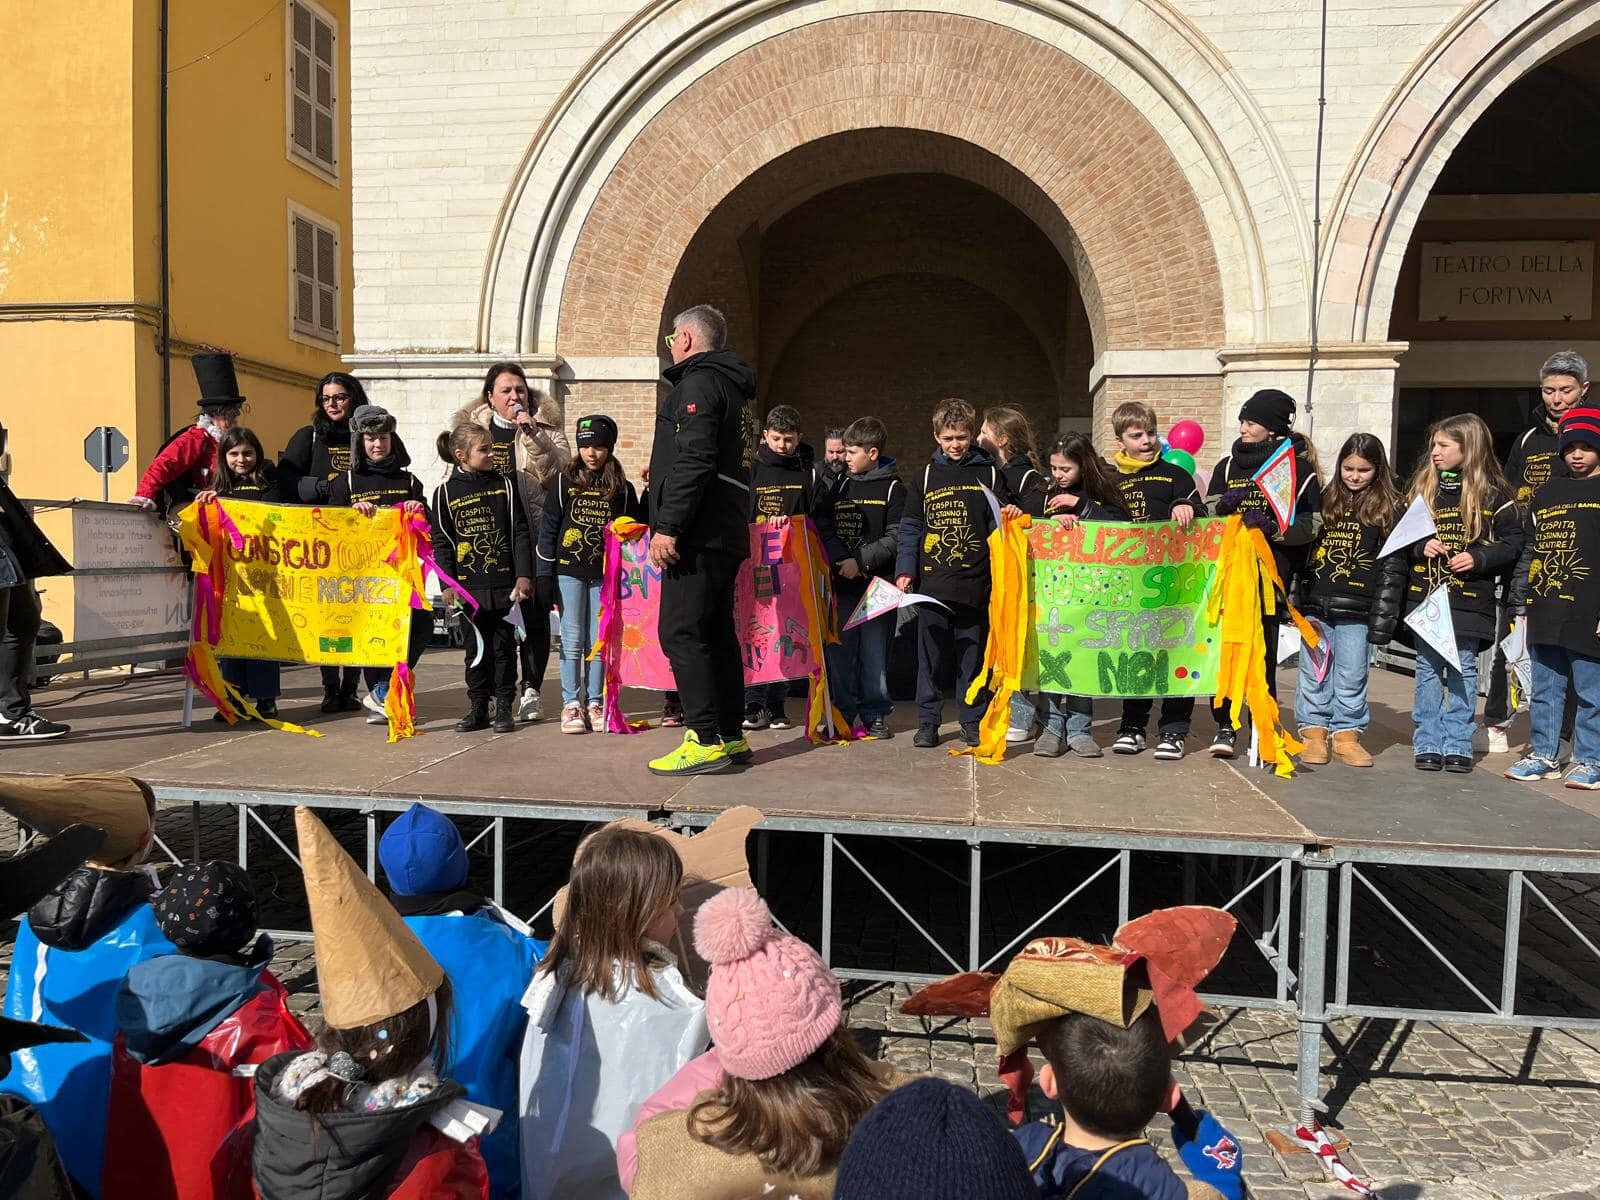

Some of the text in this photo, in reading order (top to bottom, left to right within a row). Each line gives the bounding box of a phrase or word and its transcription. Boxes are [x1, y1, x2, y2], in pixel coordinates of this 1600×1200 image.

[1433, 255, 1584, 273] TEATRO DELLA
[1459, 286, 1553, 305] FORTVNA
[935, 510, 961, 519] STANNO
[1540, 520, 1577, 532] CASPITA,
[1326, 531, 1354, 540] STANNO
[1321, 539, 1353, 548] SENTIRE
[1537, 540, 1568, 550] SENTIRE
[317, 575, 400, 604] RAGAZZI
[1078, 607, 1196, 650] SPAZI
[1039, 649, 1169, 694] X NOI
